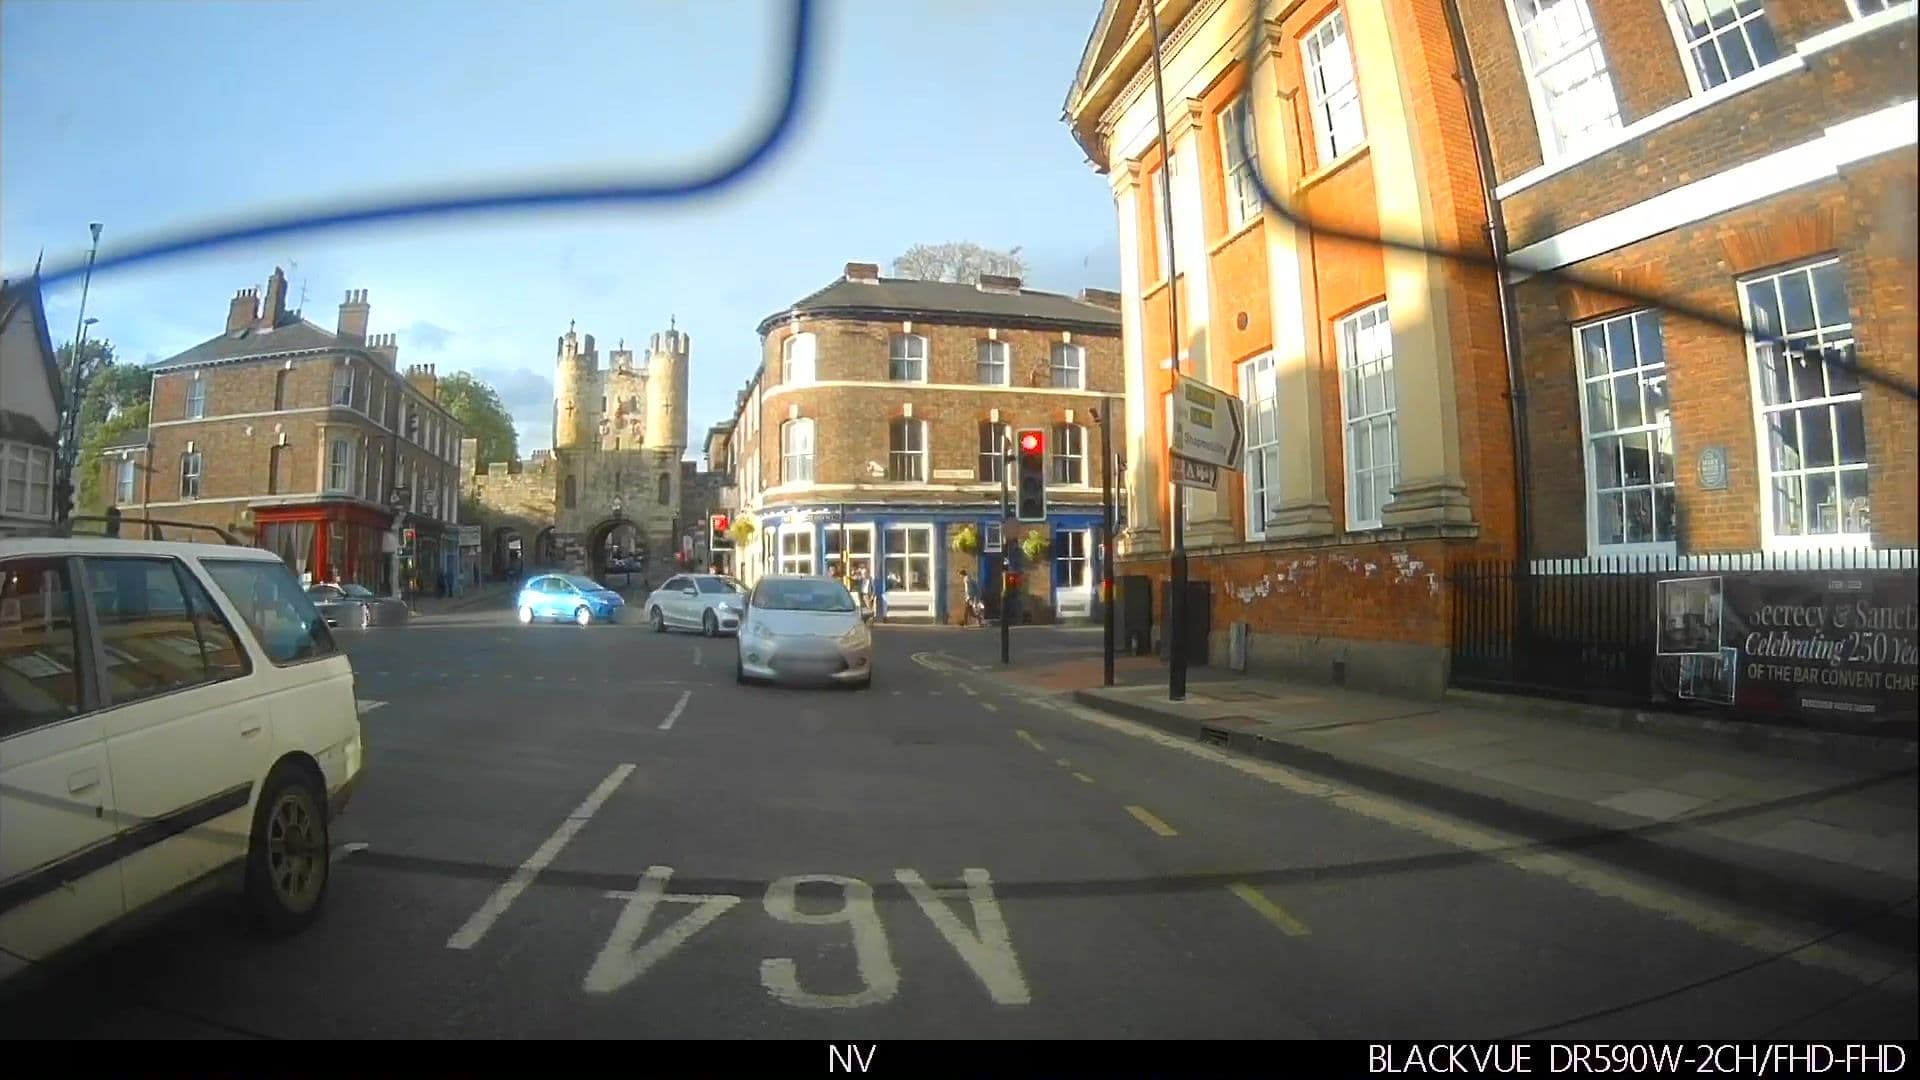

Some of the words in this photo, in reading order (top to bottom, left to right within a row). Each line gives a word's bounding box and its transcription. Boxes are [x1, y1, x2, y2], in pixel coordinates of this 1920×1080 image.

[1745, 630, 1845, 666] Celebrating
[1847, 631, 1887, 664] 250
[1748, 664, 1765, 680] OF
[1767, 665, 1792, 682] THE
[1793, 666, 1818, 684] BAR
[1821, 669, 1882, 689] CONVENT
